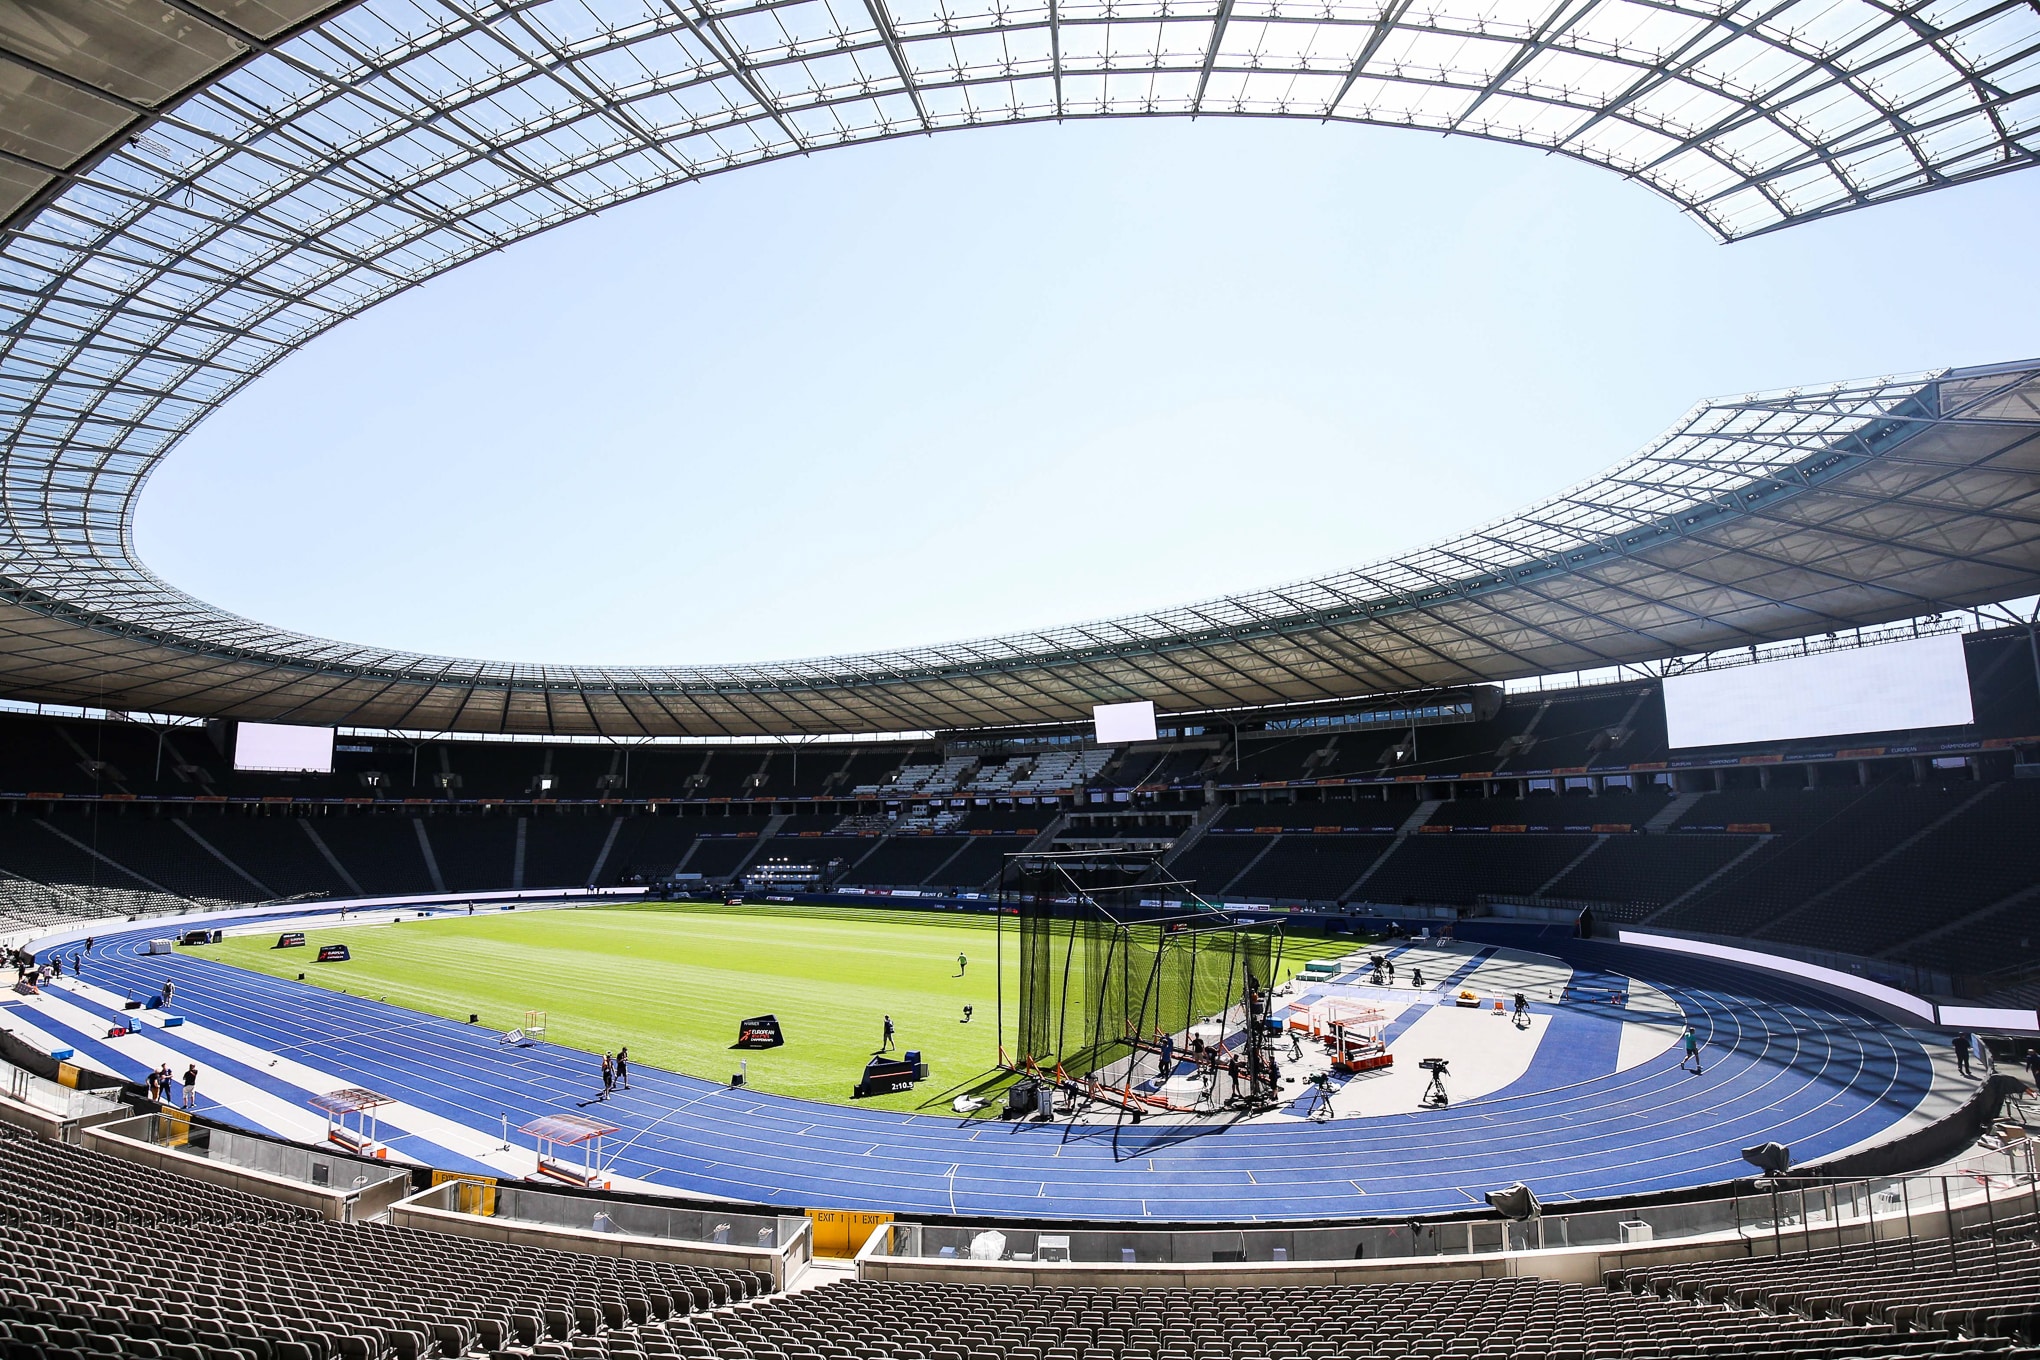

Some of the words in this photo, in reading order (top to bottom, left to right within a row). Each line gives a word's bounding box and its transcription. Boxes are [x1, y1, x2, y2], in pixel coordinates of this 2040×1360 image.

[1940, 742, 1980, 750] CHAMPIONSHIPS
[891, 1081, 914, 1091] 2:10.5
[817, 1212, 836, 1223] EXIT
[861, 1215, 880, 1225] EXIT
